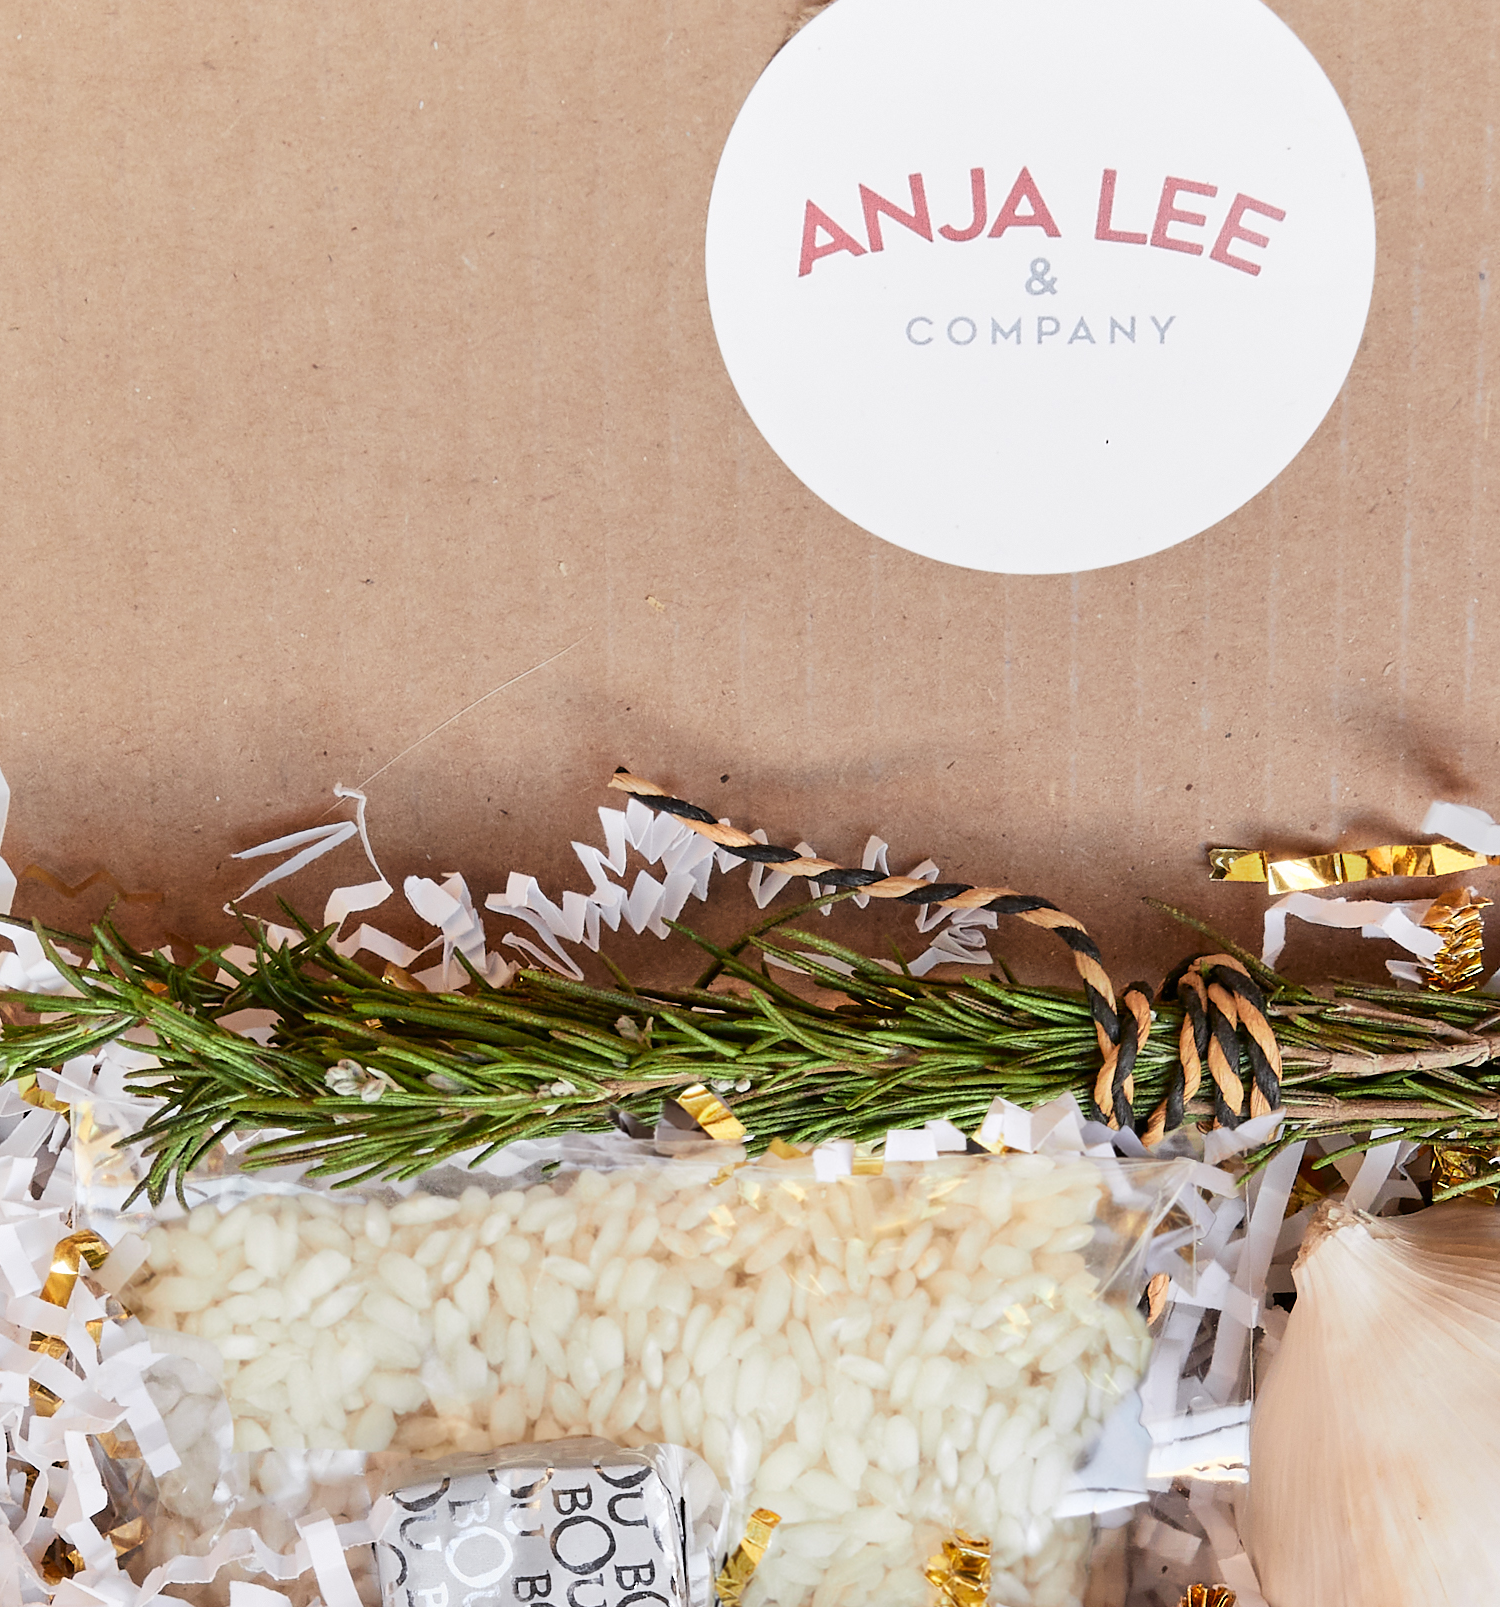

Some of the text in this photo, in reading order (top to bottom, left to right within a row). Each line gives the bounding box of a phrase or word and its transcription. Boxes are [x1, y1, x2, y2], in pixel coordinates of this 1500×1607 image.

[798, 166, 1286, 278] ANJA LEE
[1025, 258, 1057, 295] &
[906, 316, 1175, 345] COMPANY
